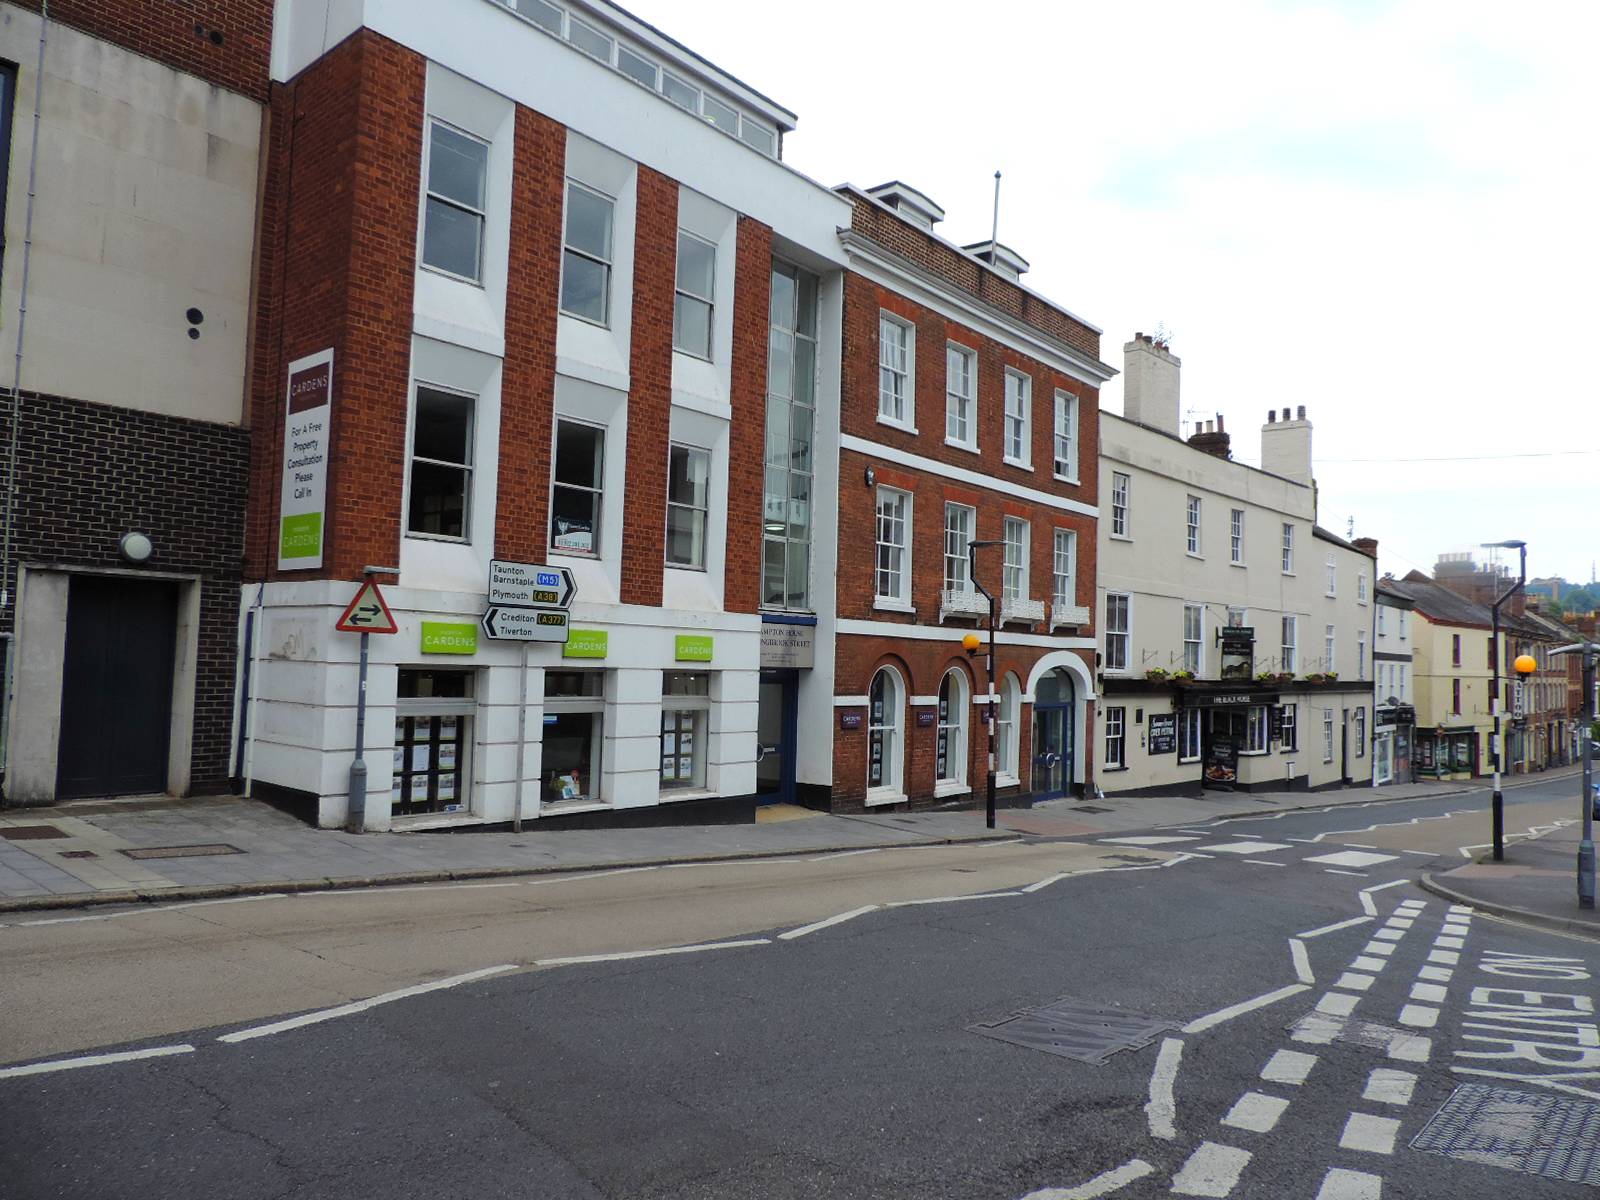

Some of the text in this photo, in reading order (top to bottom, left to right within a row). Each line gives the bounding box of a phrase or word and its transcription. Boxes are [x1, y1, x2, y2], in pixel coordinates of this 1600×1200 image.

[291, 375, 328, 397] CARDENS
[292, 422, 322, 437] For A Free
[293, 440, 318, 453] Property
[288, 454, 323, 469] Consultation
[295, 471, 313, 483] Please
[294, 487, 313, 499] Call In
[493, 564, 525, 575] Taunton
[493, 574, 558, 586] Barnstaple (M5)
[492, 589, 558, 601] Plymouth (A38)
[501, 612, 566, 625] Crediton (A377)
[500, 626, 532, 636] Tiverton
[424, 635, 475, 647] CARDENS
[1514, 681, 1522, 718] ATTOO
[1478, 950, 1591, 981] NO
